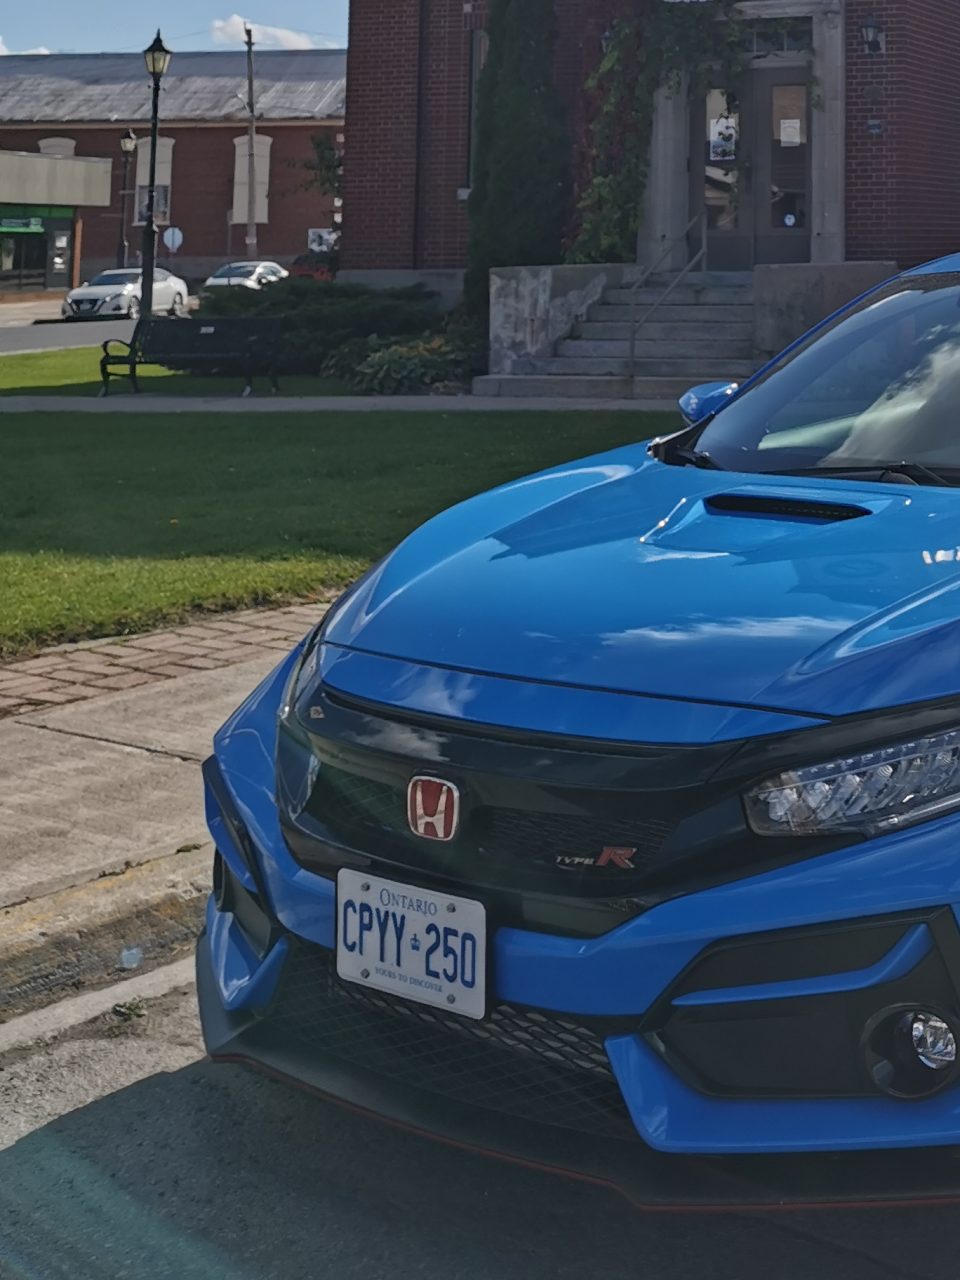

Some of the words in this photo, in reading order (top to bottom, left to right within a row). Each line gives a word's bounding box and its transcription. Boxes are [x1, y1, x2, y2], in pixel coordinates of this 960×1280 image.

[555, 856, 595, 865] TYPE
[595, 846, 638, 869] R
[380, 888, 437, 916] ONTARIO
[343, 899, 406, 968] CPYY
[425, 922, 477, 989] 250
[398, 972, 408, 983] TO
